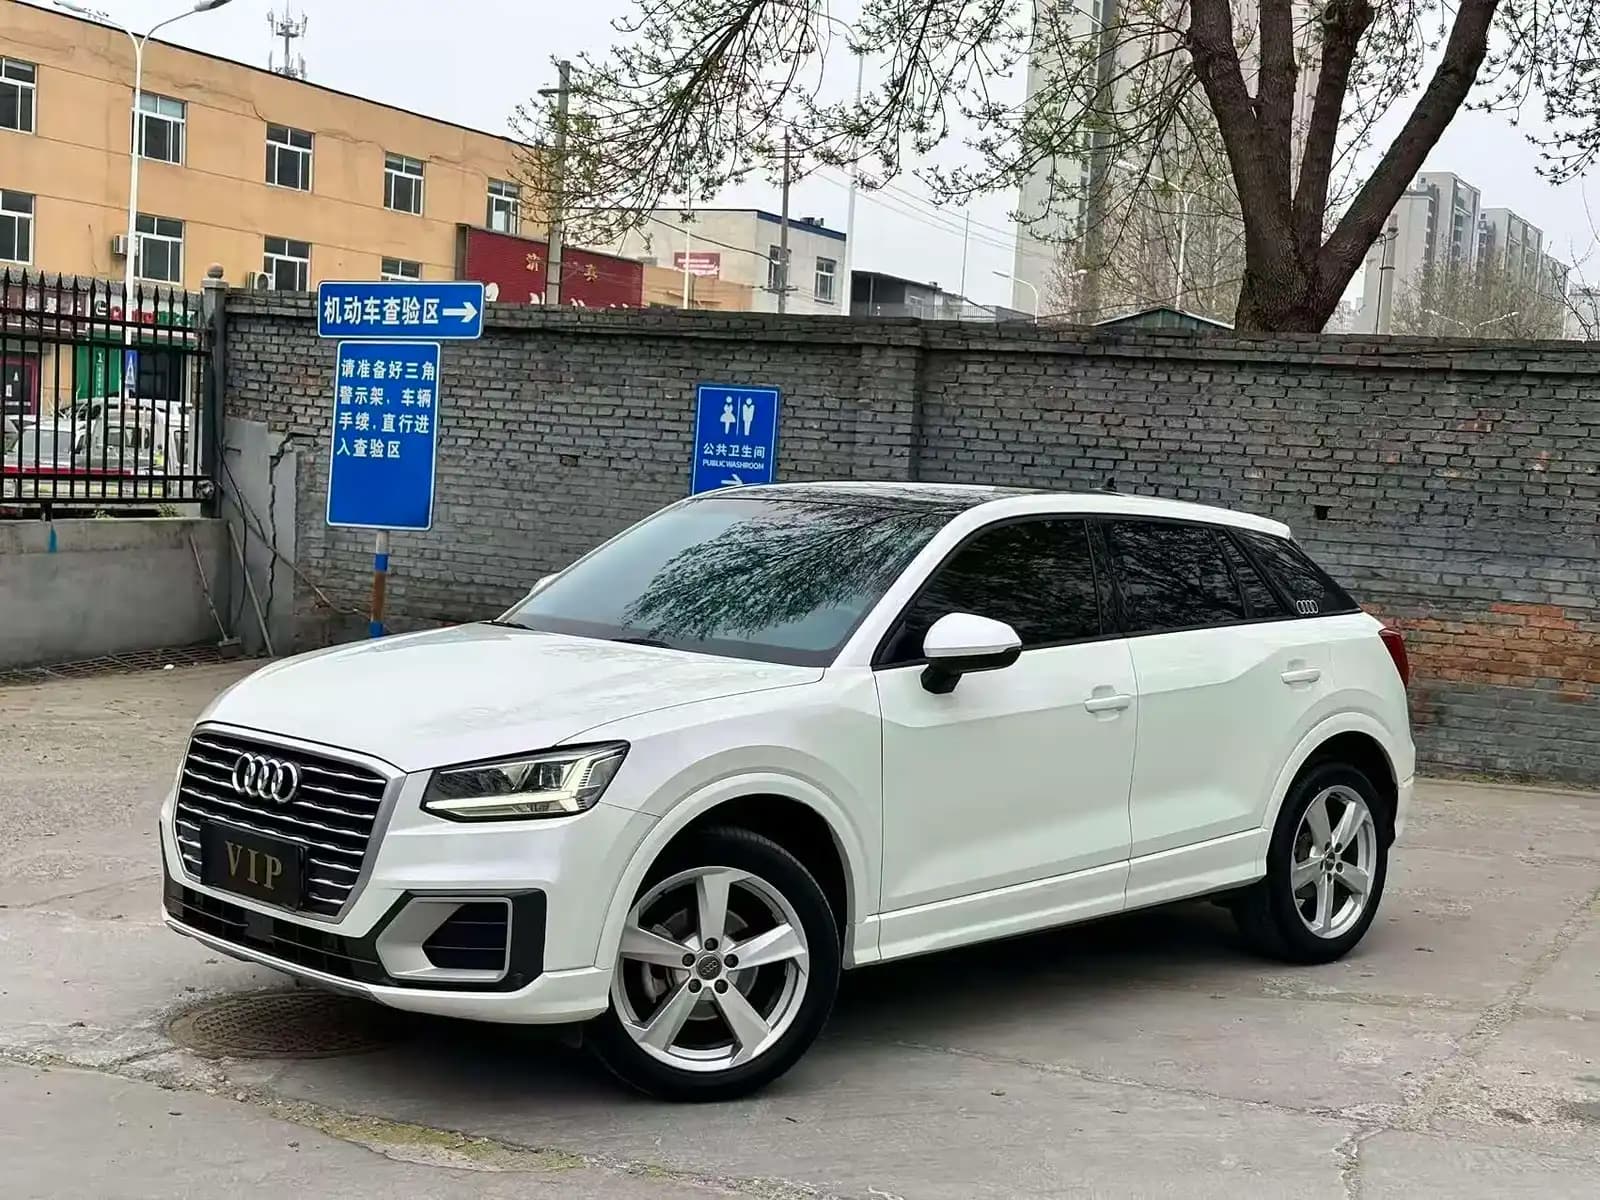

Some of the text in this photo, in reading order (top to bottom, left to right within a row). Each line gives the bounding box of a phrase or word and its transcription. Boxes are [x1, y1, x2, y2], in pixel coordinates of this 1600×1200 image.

[323, 296, 440, 325] 机动车查验区
[341, 358, 435, 381] 请准备好三角
[336, 437, 401, 458] 入查验区
[703, 442, 765, 459] 公共卫生间
[225, 840, 282, 890] VIP
